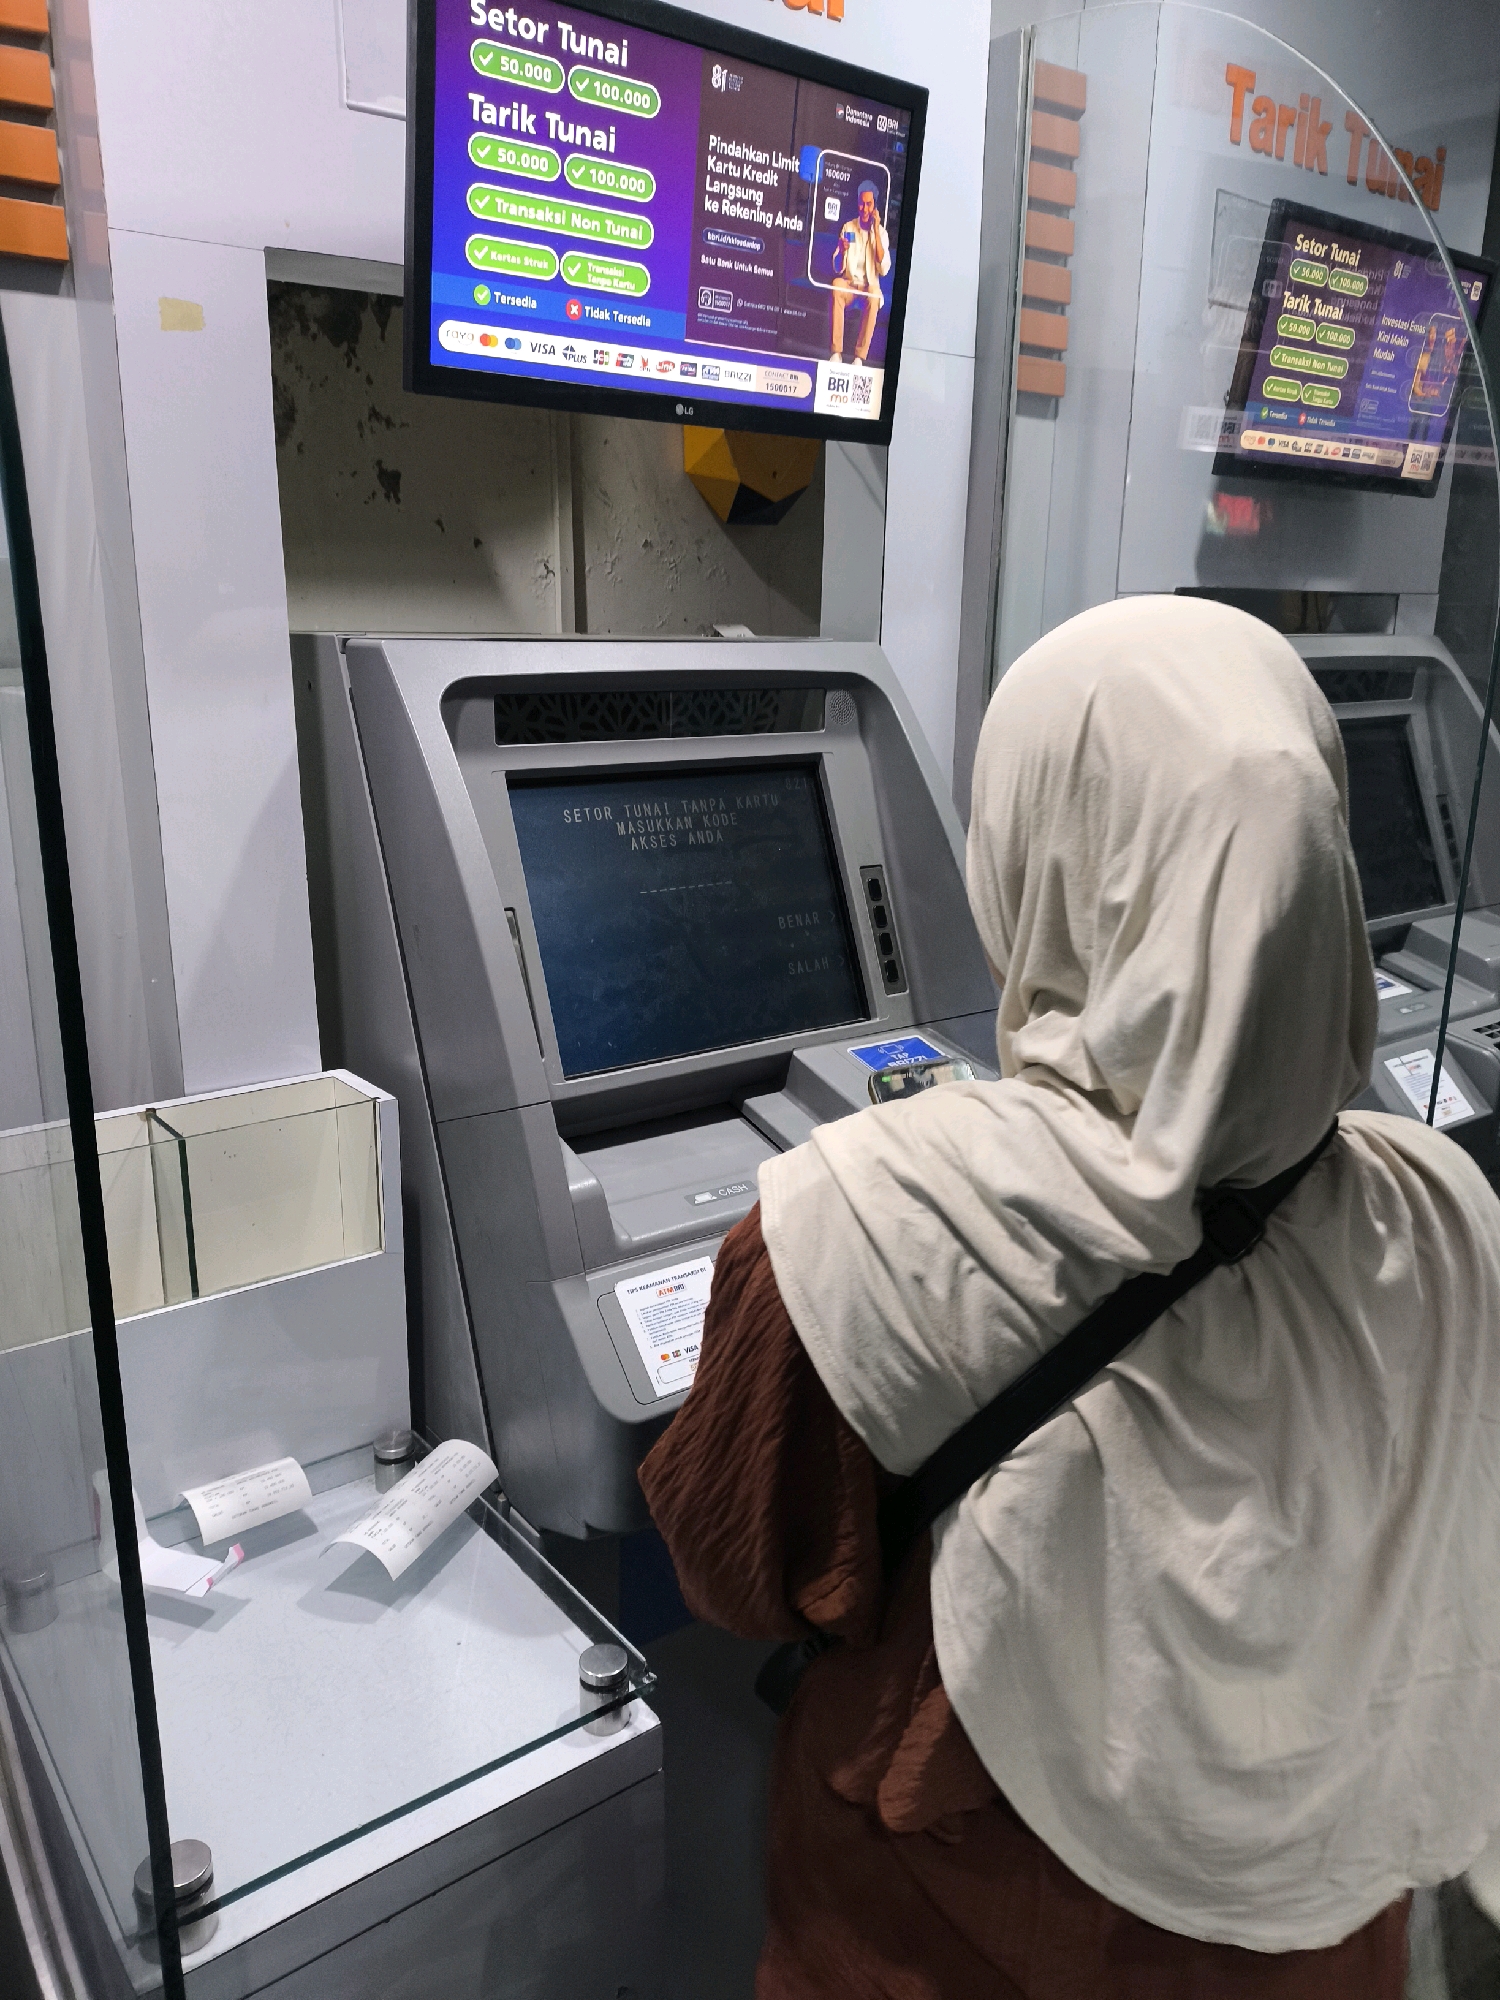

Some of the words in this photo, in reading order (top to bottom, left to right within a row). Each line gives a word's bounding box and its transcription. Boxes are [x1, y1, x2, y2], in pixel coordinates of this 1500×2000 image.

[470, 0, 549, 42] Setor
[557, 20, 628, 67] Tunai
[500, 56, 552, 83] 50.000
[593, 81, 651, 109] 100.000
[468, 93, 537, 135] Tarik
[545, 111, 616, 153] Tunai
[1225, 62, 1333, 176] Tarik
[1345, 110, 1447, 212] Tunai
[497, 147, 549, 172] 50.000
[708, 134, 770, 165] Pindahkan
[772, 151, 800, 173] Limit
[589, 168, 646, 194] 100.000
[707, 155, 740, 178] Kartu
[743, 164, 778, 187] Kredit
[705, 175, 763, 206] Langsung
[495, 197, 566, 226] Transaksi
[571, 213, 600, 232] Non
[605, 220, 643, 241] Tunai
[704, 194, 719, 213] ke
[721, 199, 773, 228] Rekening
[775, 211, 803, 231] Anda
[1294, 233, 1328, 258] Setor
[1330, 243, 1361, 267] Tunai
[524, 255, 549, 270] Struk
[701, 254, 716, 265] Satu
[717, 257, 733, 269] Bank
[734, 261, 752, 272] Untuk
[754, 265, 773, 277] Semua
[493, 291, 537, 309] Tersedia
[1283, 291, 1312, 313] Tarik
[1313, 298, 1345, 320] Tunai
[584, 305, 610, 321] Tidak
[612, 310, 651, 328] Tersedia
[1381, 314, 1410, 330] Investasi
[1409, 322, 1426, 335] Emas
[1377, 330, 1391, 343] Kini
[530, 342, 556, 355] VISA
[568, 353, 587, 364] PLUS
[1281, 353, 1311, 368] Transaksi
[1312, 359, 1325, 370] Non
[1326, 362, 1344, 373] Tunai
[766, 382, 797, 394] 1500017
[828, 377, 850, 393] BRI
[830, 394, 848, 404] mo
[684, 407, 693, 415] LG
[563, 806, 613, 824] SETOR
[624, 801, 670, 818] TUNAI
[681, 797, 726, 814] TANPA
[736, 793, 779, 810] KARTU
[616, 815, 693, 836] MASUKKAN
[703, 812, 738, 828] KODE
[631, 834, 677, 851] AKSES
[688, 830, 724, 846] ANDA
[777, 911, 820, 930] BENAR
[788, 957, 829, 976] SALAH
[890, 1052, 909, 1060] TAP
[718, 1183, 749, 1197] CASH
[684, 1345, 699, 1354] VISA
